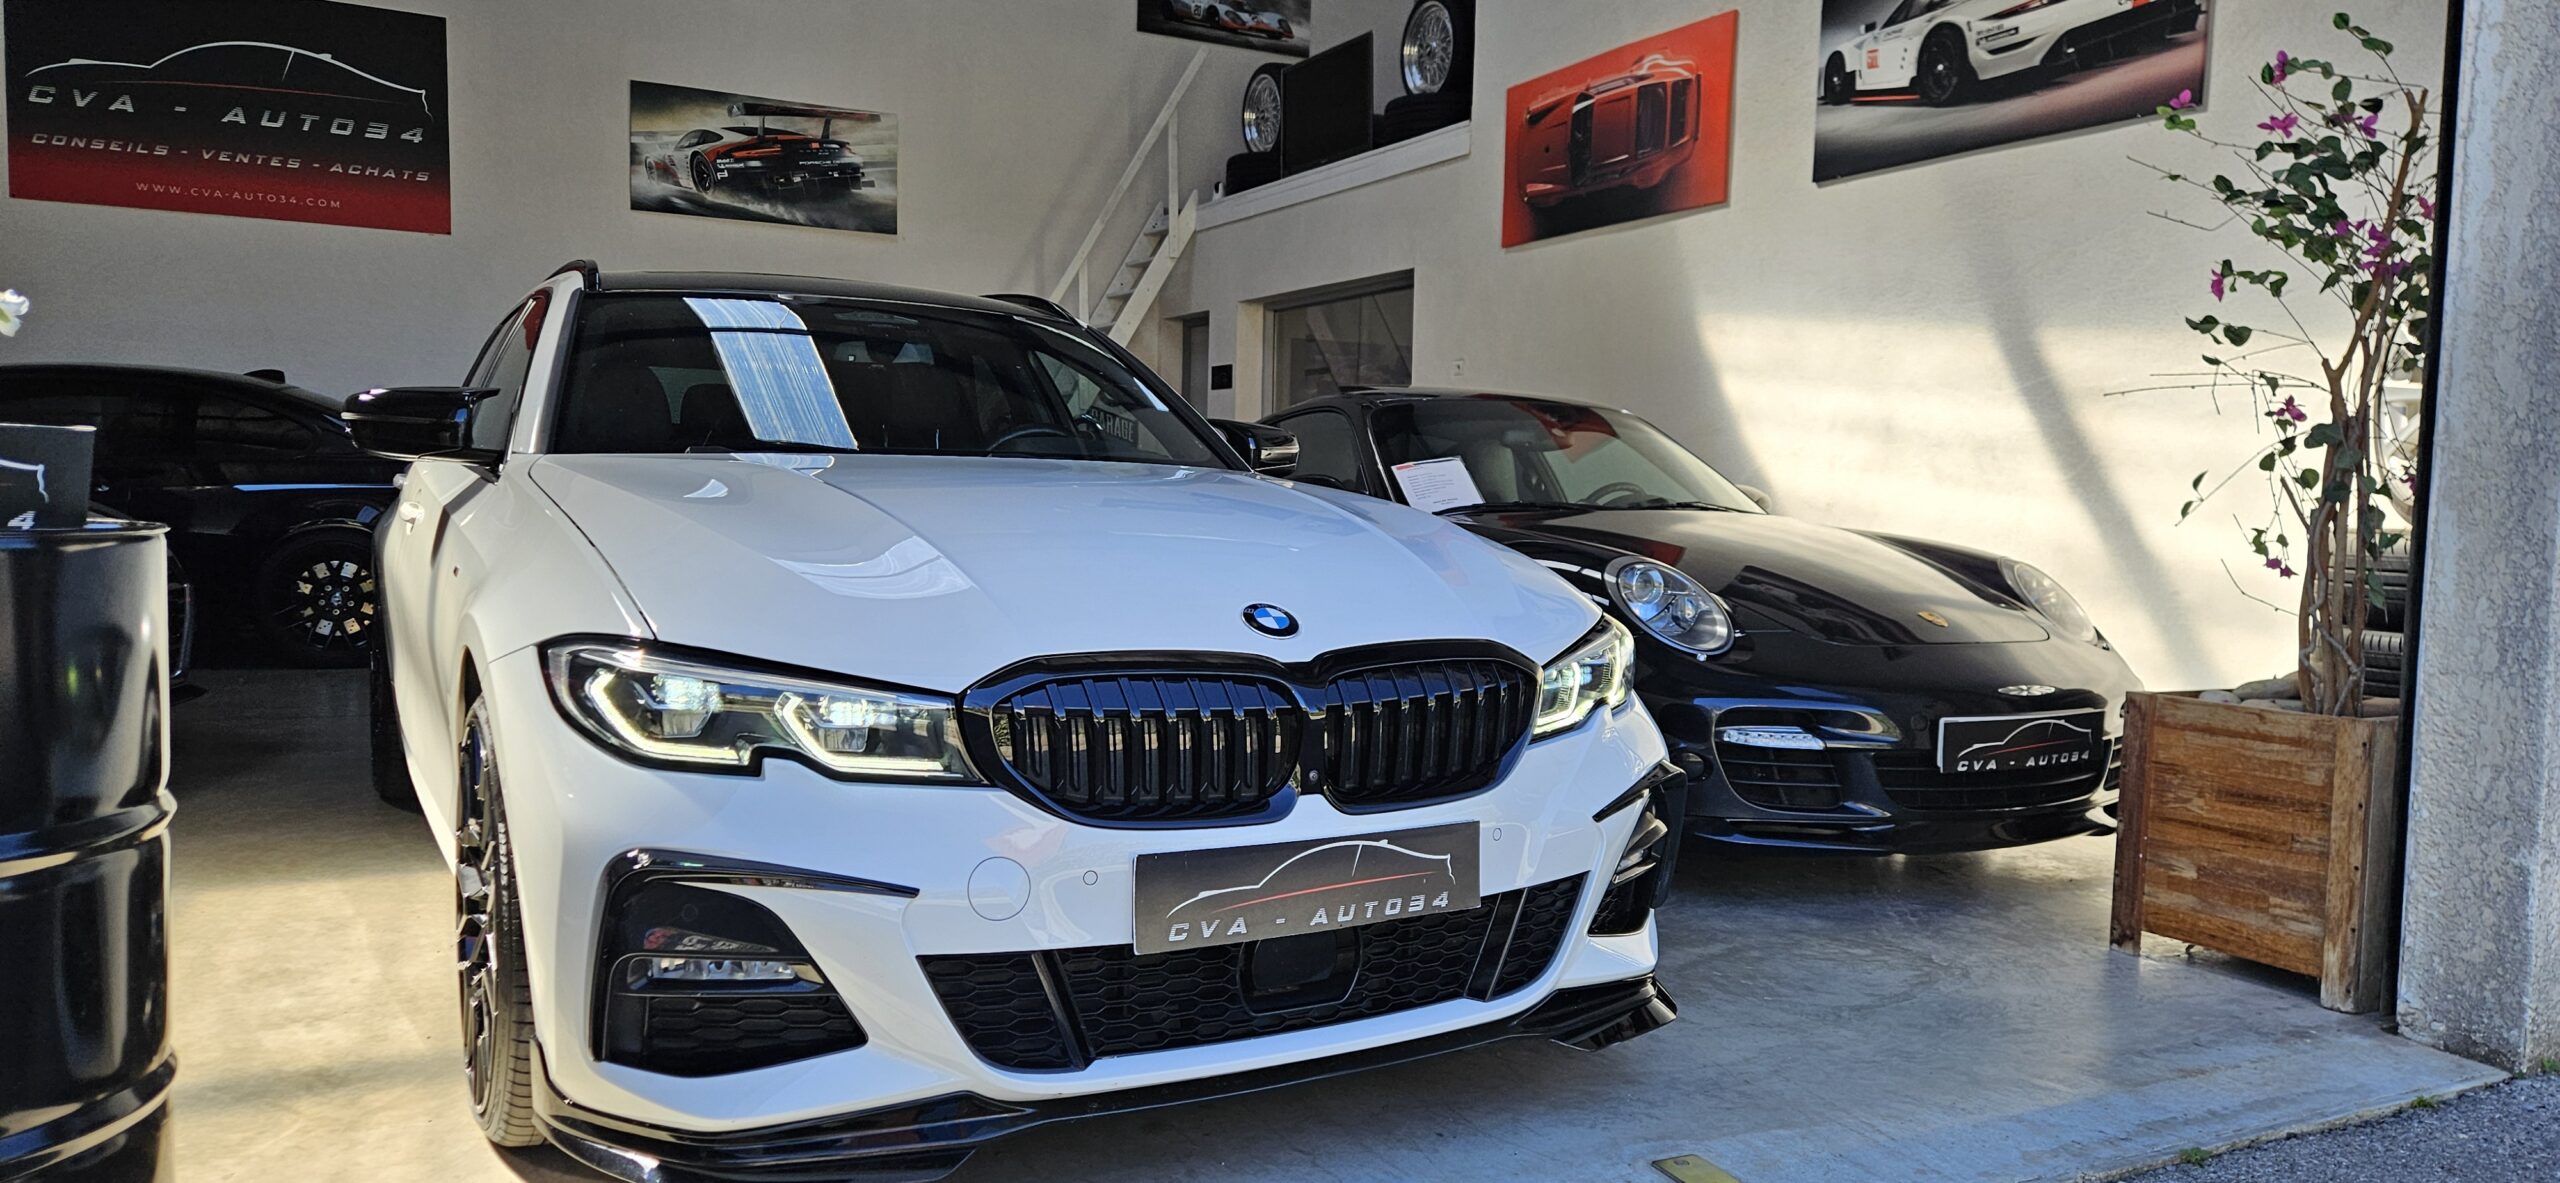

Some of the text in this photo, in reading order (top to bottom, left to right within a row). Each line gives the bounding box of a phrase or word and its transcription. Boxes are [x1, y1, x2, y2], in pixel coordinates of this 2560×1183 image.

[28, 85, 135, 113] CVA
[221, 106, 425, 144] AUTO34
[31, 133, 169, 156] CONSEILS
[202, 148, 302, 169] VENTES
[329, 162, 431, 183] ACHATS
[135, 182, 342, 209] WWW.CVA-AUTO34.COM
[1957, 760, 1997, 772] CVA
[2026, 750, 2090, 767] AUTO34
[1168, 917, 1247, 942] CVA
[1309, 891, 1450, 926] AUTO34
